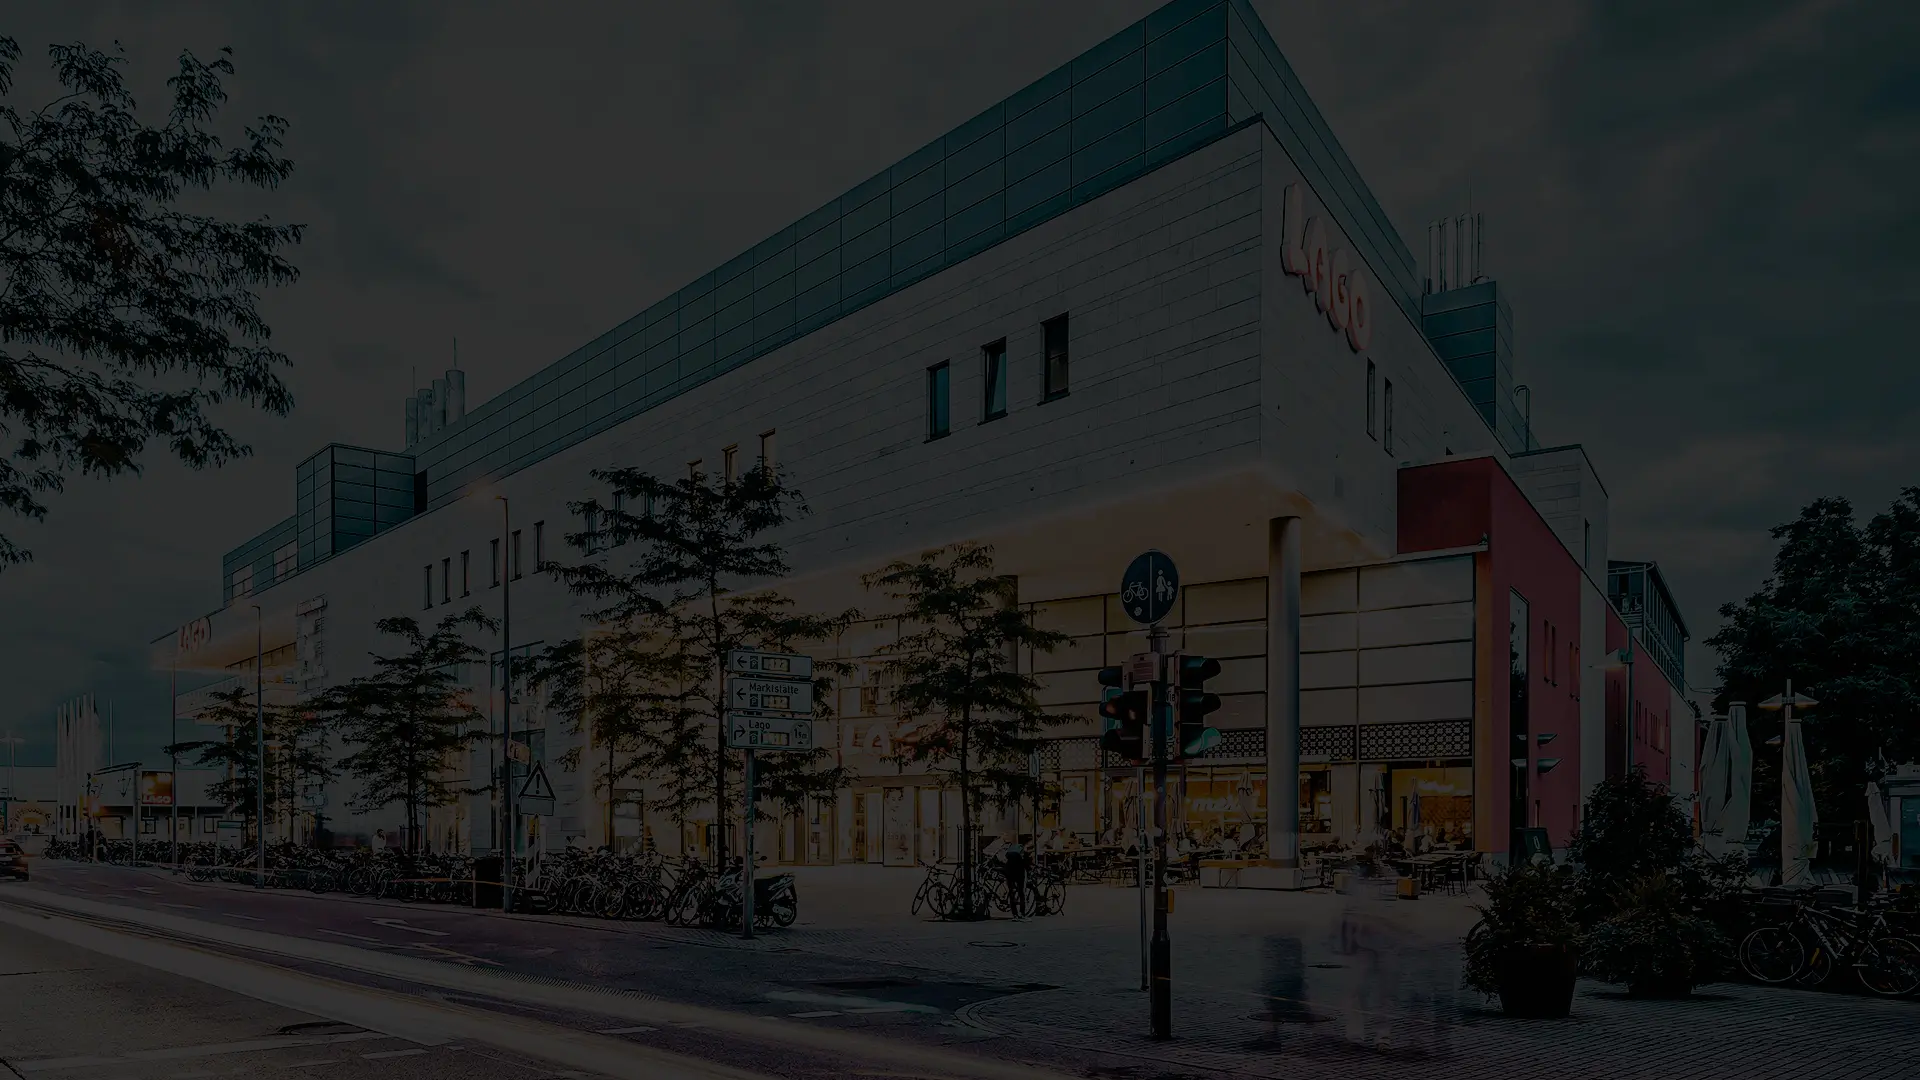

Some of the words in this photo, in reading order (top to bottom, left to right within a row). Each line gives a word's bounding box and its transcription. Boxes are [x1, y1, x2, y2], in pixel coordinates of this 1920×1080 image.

[1282, 182, 1372, 351] LAGO
[177, 616, 211, 656] LAGO
[749, 682, 799, 695] Marktstätte
[749, 720, 771, 731] Lago
[143, 794, 172, 804] LAGO
